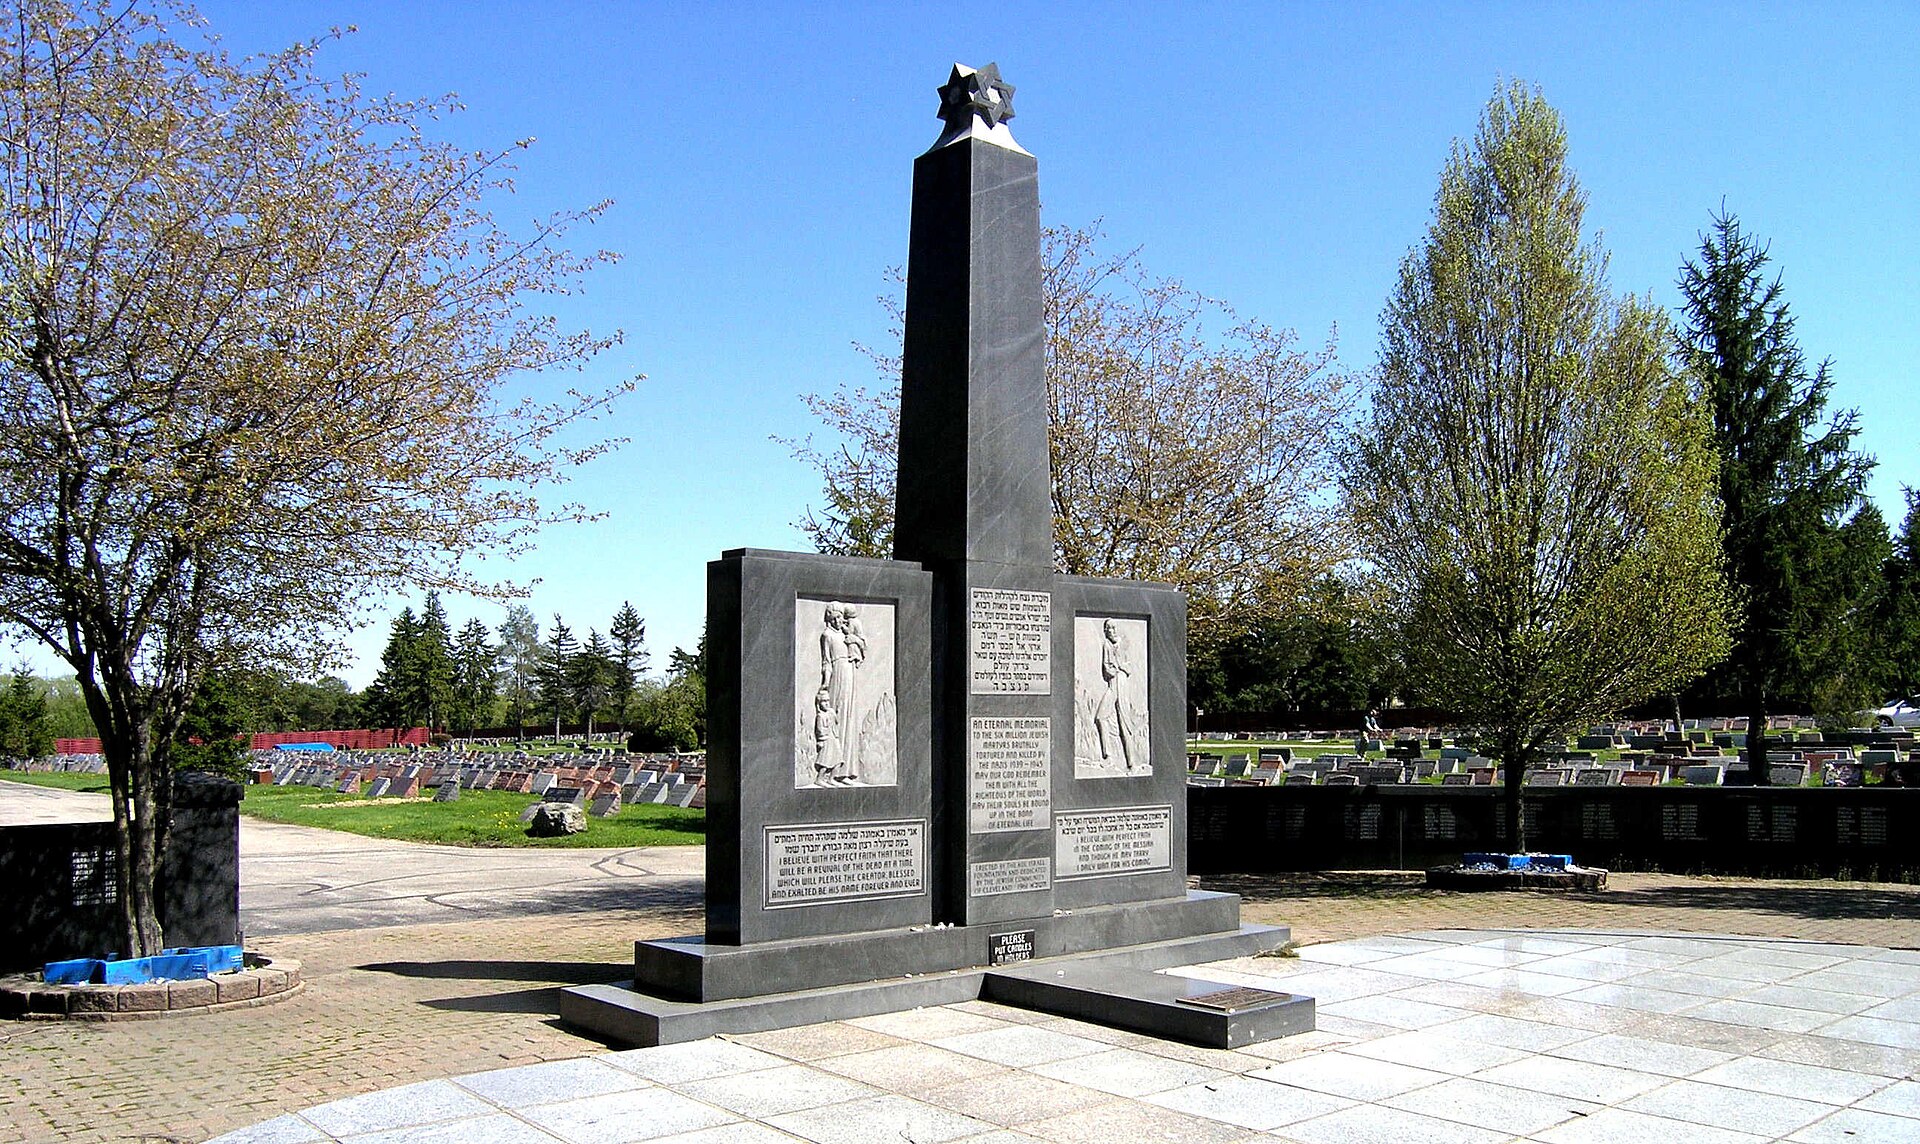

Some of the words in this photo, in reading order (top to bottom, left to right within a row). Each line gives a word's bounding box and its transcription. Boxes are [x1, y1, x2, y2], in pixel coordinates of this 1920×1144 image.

[984, 720, 1012, 729] ETERNAL
[1014, 720, 1048, 729] MEMORIAL
[997, 820, 1021, 829] ETERNAL
[1080, 835, 1100, 843] BELIEVE
[1116, 832, 1136, 840] PERFECT
[1092, 843, 1112, 851] COMING
[783, 856, 810, 865] BELIEVE
[812, 855, 828, 863] WITH
[830, 853, 857, 862] PERFECT
[859, 851, 876, 860] FAITH
[1132, 858, 1151, 866] COMING
[780, 868, 795, 876] WILL
[814, 865, 841, 873] REVIVAL
[866, 861, 882, 870] DEAD
[778, 879, 800, 887] WHICH
[819, 875, 841, 884] PLEASE
[889, 870, 914, 878] BLESSED
[974, 871, 1007, 879] FOUNDATION
[1015, 874, 1044, 883] COMMUNITY
[772, 890, 786, 898] AND
[788, 888, 817, 897] EXALTED
[841, 884, 860, 892] NAME
[861, 882, 889, 891] FOREVER
[890, 881, 903, 889] AND
[983, 885, 1013, 893] CLEVELAND
[1001, 934, 1025, 945] PLEASE
[994, 946, 1006, 955] PUT
[1007, 943, 1032, 953] CANDLES
[997, 954, 1003, 963] IN
[1005, 952, 1030, 963] HOLDERS
